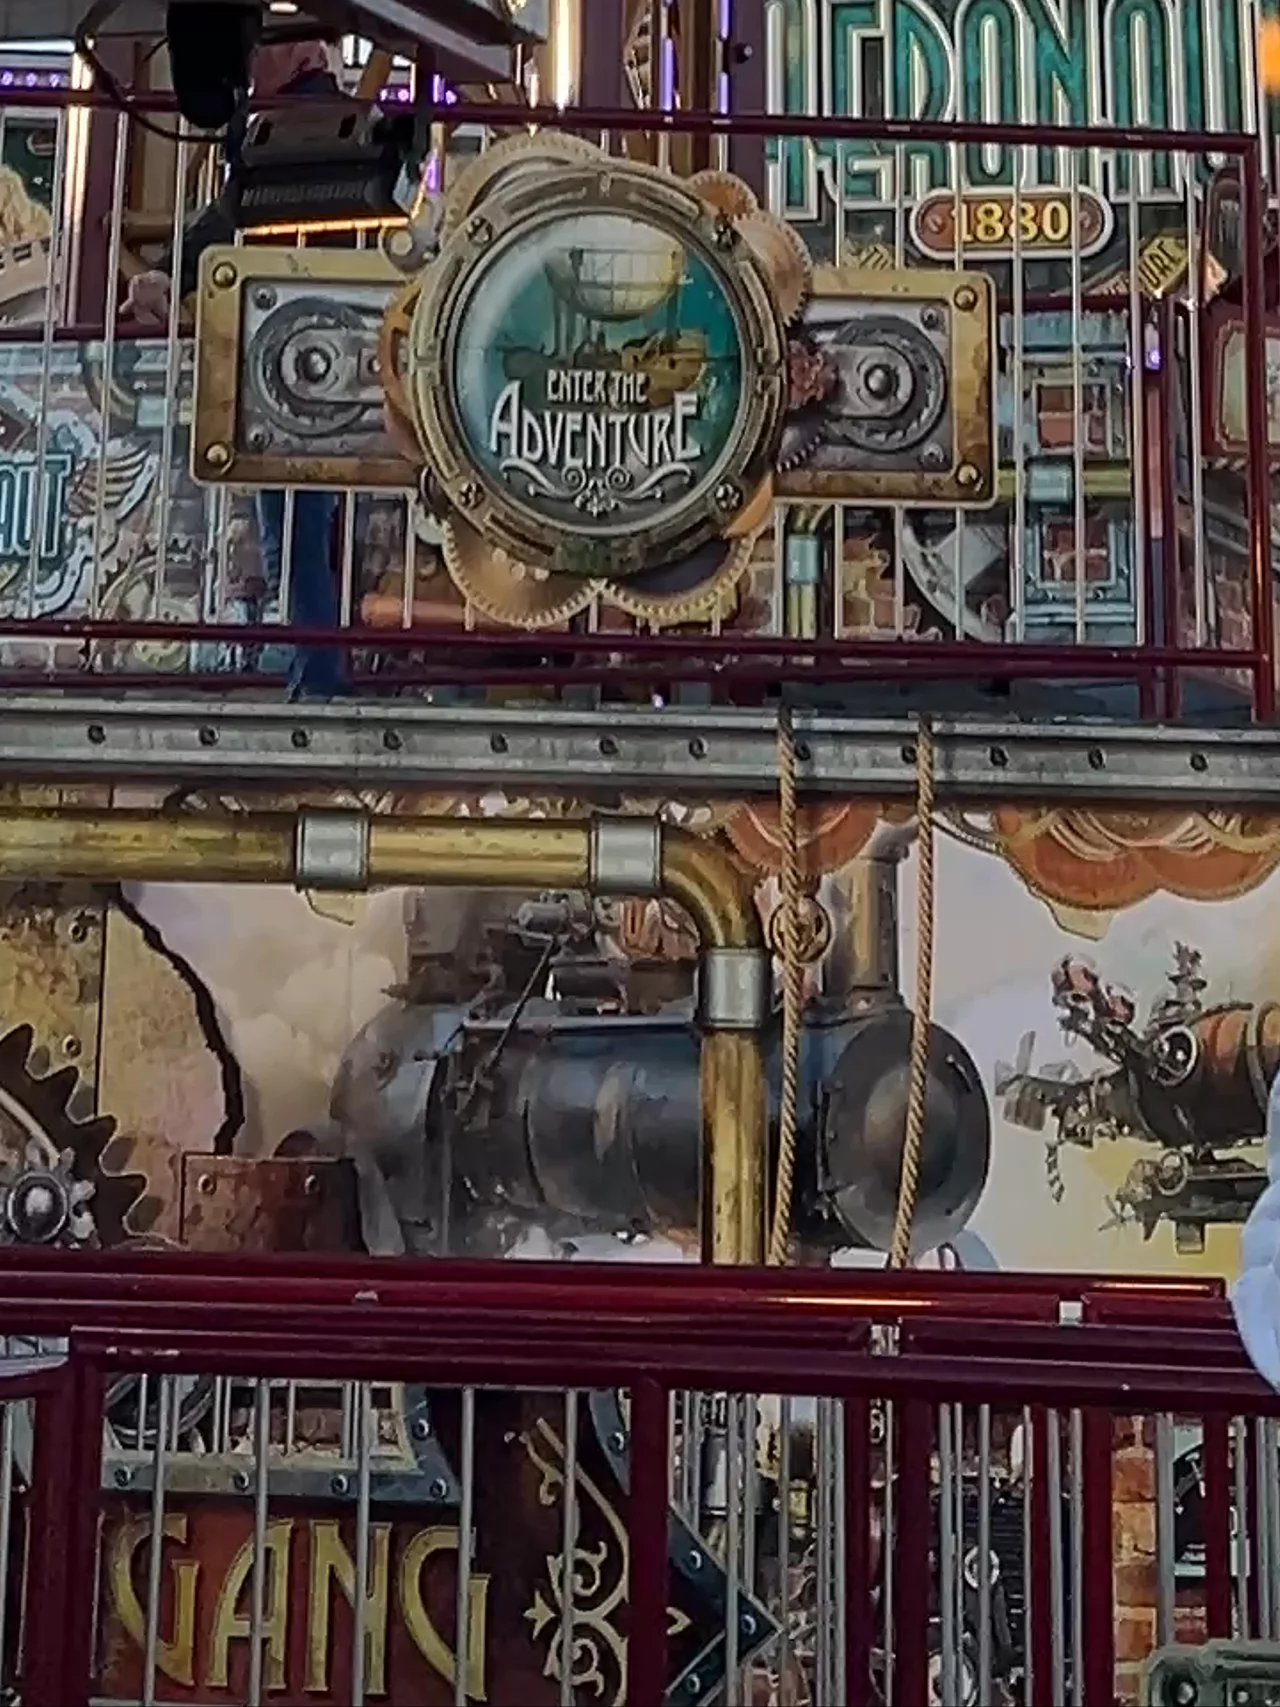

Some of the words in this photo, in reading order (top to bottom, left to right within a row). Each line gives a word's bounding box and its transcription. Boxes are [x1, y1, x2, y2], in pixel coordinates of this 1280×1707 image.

[952, 200, 1071, 243] 1880
[546, 368, 606, 404] ENTER
[607, 370, 648, 404] THE
[490, 379, 701, 469] ADVENTURE
